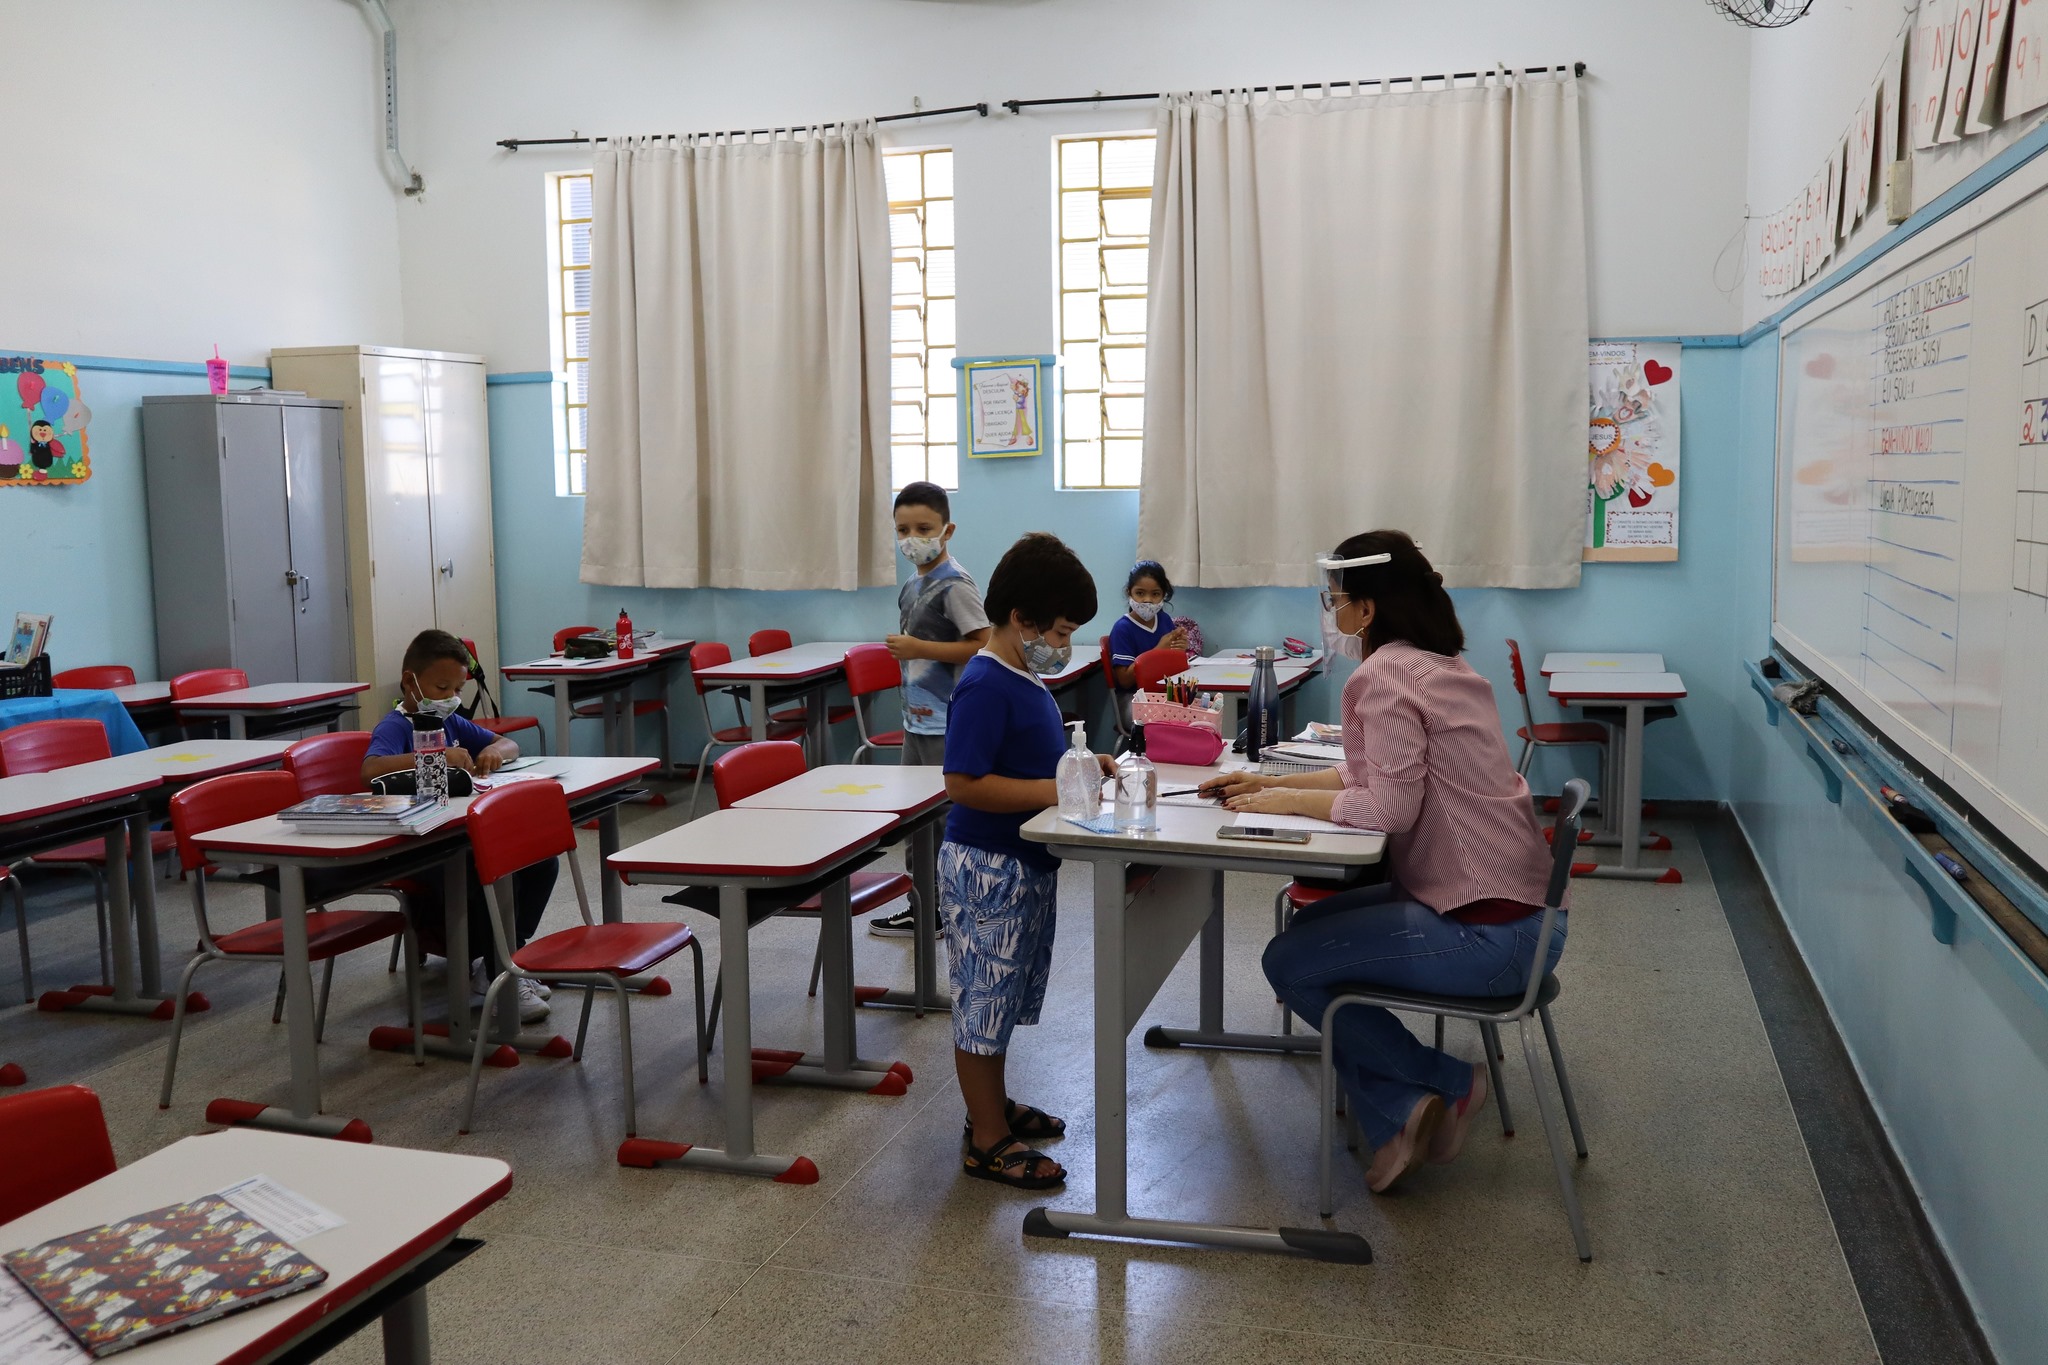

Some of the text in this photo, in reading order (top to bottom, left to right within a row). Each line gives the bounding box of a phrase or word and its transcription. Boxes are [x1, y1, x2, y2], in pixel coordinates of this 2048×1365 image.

[1932, 24, 1945, 71] N
[1957, 7, 1972, 60] O
[1884, 293, 1899, 323] HOJE
[1910, 285, 1920, 315] DIA
[1924, 262, 1970, 310] 03-05-2021
[1885, 314, 1932, 349] SEGUNDA-FEIRA
[2027, 313, 2038, 357] D
[1922, 336, 1942, 366] SUSY
[1882, 377, 1892, 404] EU
[1881, 425, 1914, 455] BEM-VINDO
[2022, 403, 2036, 444] 2
[1898, 483, 1935, 515] PORTUGUESA
